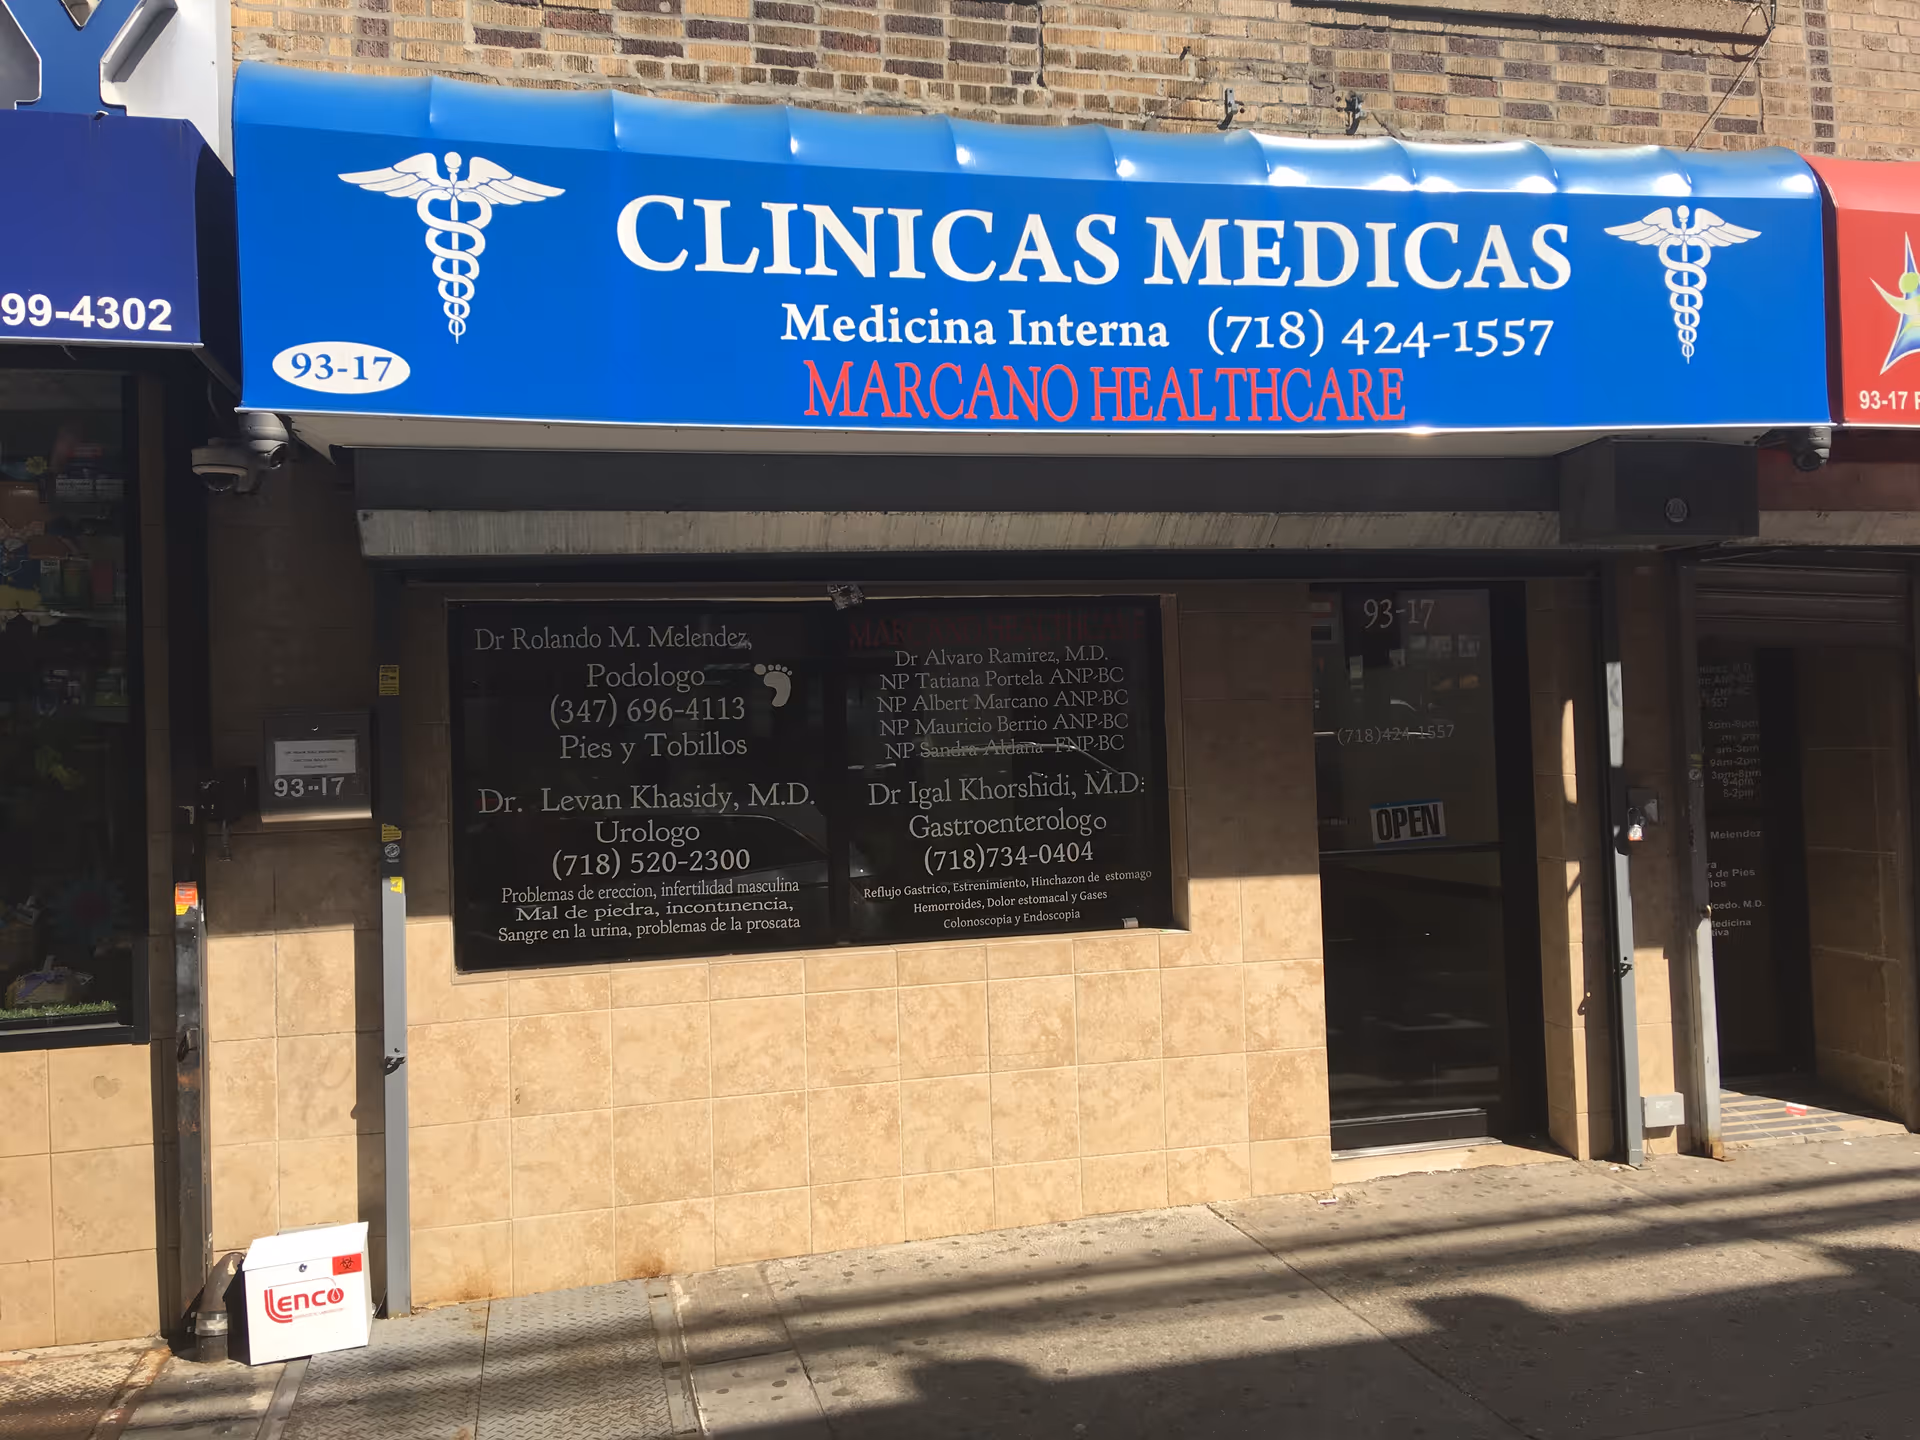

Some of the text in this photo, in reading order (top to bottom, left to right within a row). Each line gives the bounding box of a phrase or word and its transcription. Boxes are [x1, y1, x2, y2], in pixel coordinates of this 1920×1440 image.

[616, 194, 1571, 290] CLINICAS MEDICAS
[780, 303, 1554, 358] Medicina Interna (718) 424-1557
[291, 352, 393, 382] 93-17
[803, 359, 1405, 422] MARCANO HEALTHCARE
[1859, 390, 1908, 410] 93-17
[1363, 599, 1435, 629] 93-17
[474, 625, 752, 650] Dr Rolando M. Melendez,
[895, 645, 1109, 667] Dr Alvaro Ramirez, M.D.
[586, 662, 705, 693] Podologo
[880, 667, 1124, 690] NP Tatiana Portela ANP-BC
[550, 693, 745, 730] (347) 696-4113
[878, 689, 1128, 712] NP Albert Marcano ANP-BC
[880, 712, 1128, 736] NP Mauricio Berrio ANP-BC
[559, 732, 747, 764] Pies y Tobillos
[886, 743, 915, 759] NP
[921, 741, 978, 758] Sandra
[478, 782, 815, 814] Dr. Levan Khasidy, M.D.
[869, 783, 900, 805] Dr
[909, 780, 952, 809] Igal
[959, 776, 1076, 802] Khorshidi,
[595, 821, 700, 847] Urologo
[909, 808, 1107, 838] Gastroenterologo
[1376, 804, 1441, 841] OPEN
[552, 848, 750, 880] (718) 520-2300
[924, 841, 1093, 875] (718)734-0404
[501, 878, 799, 904] Problemas de ereccion, infertilidad masculina
[864, 869, 1152, 900] Reflujo Gastrico, Estrenimiento, Hinchazon de estomago
[515, 897, 794, 922] Mal de piedra, incontinencia,
[913, 889, 1107, 914] Hemorroides, Dolor estomacal y Gases
[498, 927, 548, 944] Sangre
[552, 927, 570, 939] en
[574, 924, 587, 938] la
[590, 922, 632, 938] urina,
[636, 918, 707, 939] problemas
[710, 916, 727, 931] de
[730, 915, 742, 931] la
[943, 909, 1080, 930] Colonoscopia y Endoscopia
